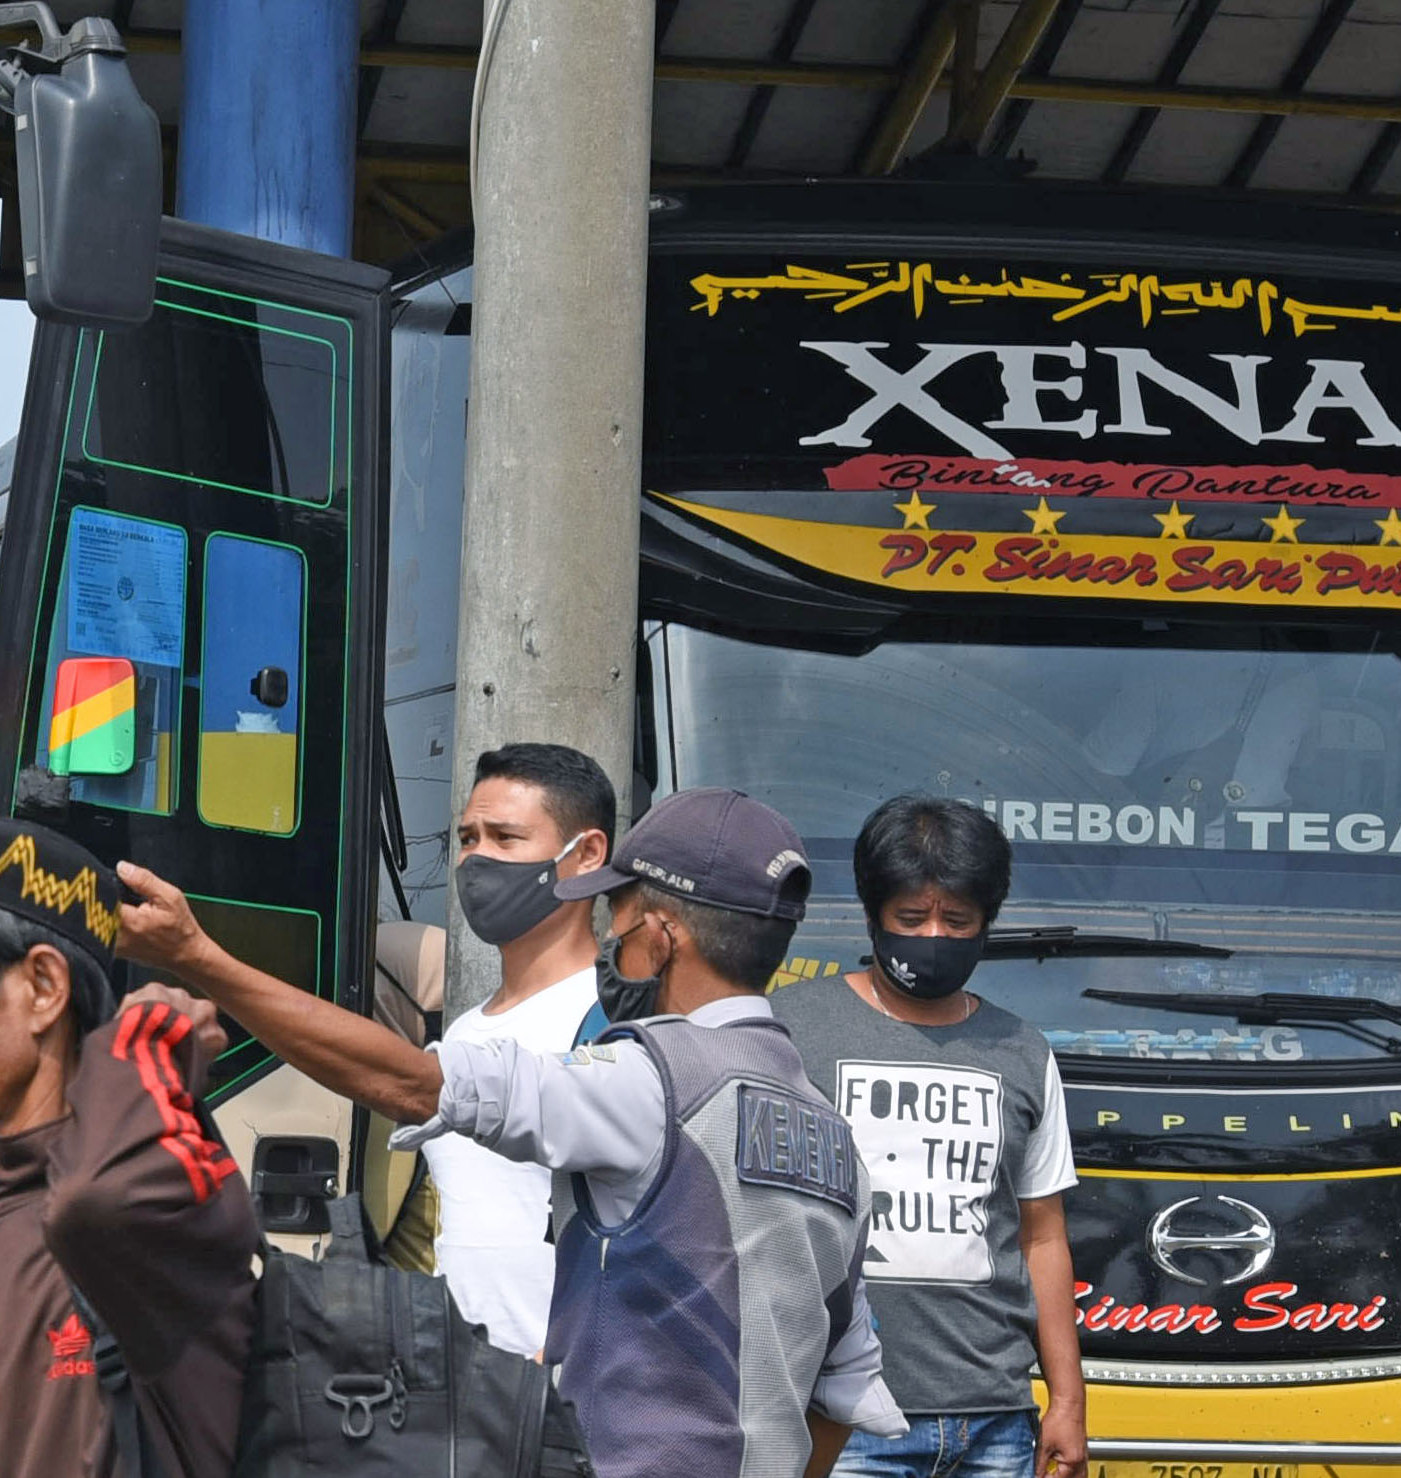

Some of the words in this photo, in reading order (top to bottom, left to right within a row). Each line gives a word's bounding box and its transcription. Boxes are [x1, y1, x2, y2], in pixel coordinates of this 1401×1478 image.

[879, 461, 1115, 495] Bintang
[1133, 469, 1381, 502] Pantura
[879, 534, 977, 580] PT.
[983, 538, 1160, 587] Sinar
[1166, 546, 1314, 595] Sari
[982, 799, 1195, 845] REBON
[845, 1078, 995, 1127] FORGET
[922, 1138, 995, 1184] THE
[871, 1190, 987, 1236] RULES
[1233, 1281, 1387, 1333] Sari
